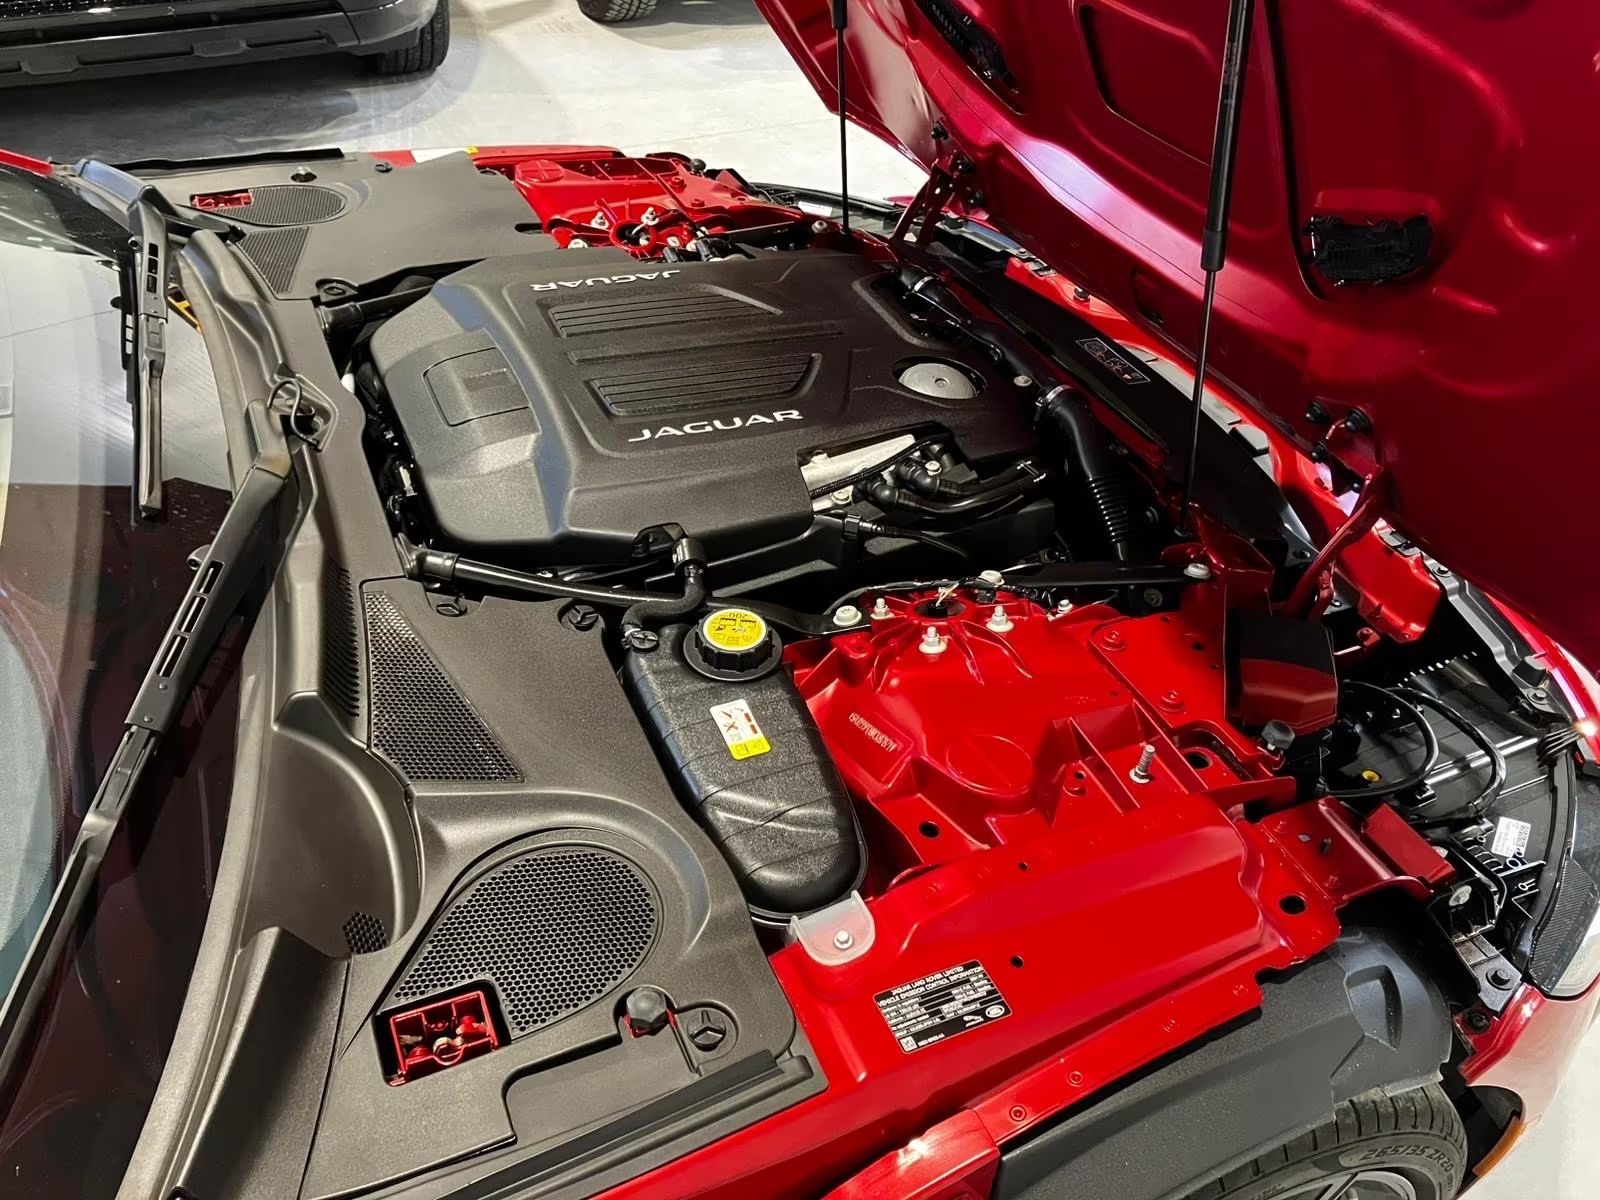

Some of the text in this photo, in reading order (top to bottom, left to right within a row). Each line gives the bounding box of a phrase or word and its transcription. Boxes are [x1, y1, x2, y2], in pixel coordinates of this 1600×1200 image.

[530, 270, 681, 291] JAGUAR
[628, 409, 804, 442] JAGUAR
[891, 984, 912, 996] JAGUAR
[911, 979, 926, 989] LAND
[925, 973, 944, 983] ROVER
[942, 966, 964, 978] LIMITED
[925, 978, 949, 990] CONTROL
[1360, 1143, 1430, 1161] 265/35
